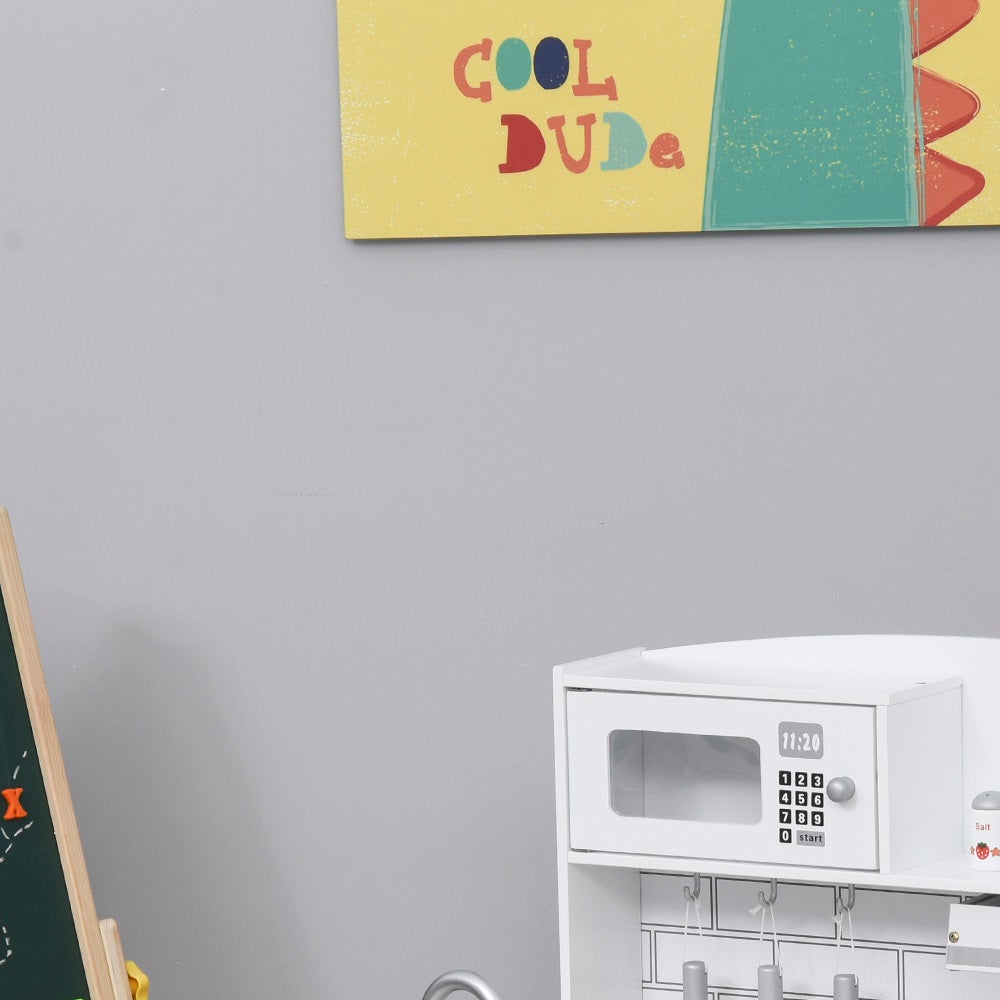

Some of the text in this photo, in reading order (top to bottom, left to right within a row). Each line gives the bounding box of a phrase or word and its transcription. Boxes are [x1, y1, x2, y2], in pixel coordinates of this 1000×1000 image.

[453, 36, 619, 103] COOL
[782, 731, 821, 752] 11:20
[782, 773, 821, 787] 1 2 3
[782, 792, 821, 806] 4 5 6
[782, 811, 821, 825] 7 8 9
[975, 822, 992, 831] Salt
[799, 833, 823, 843] start
